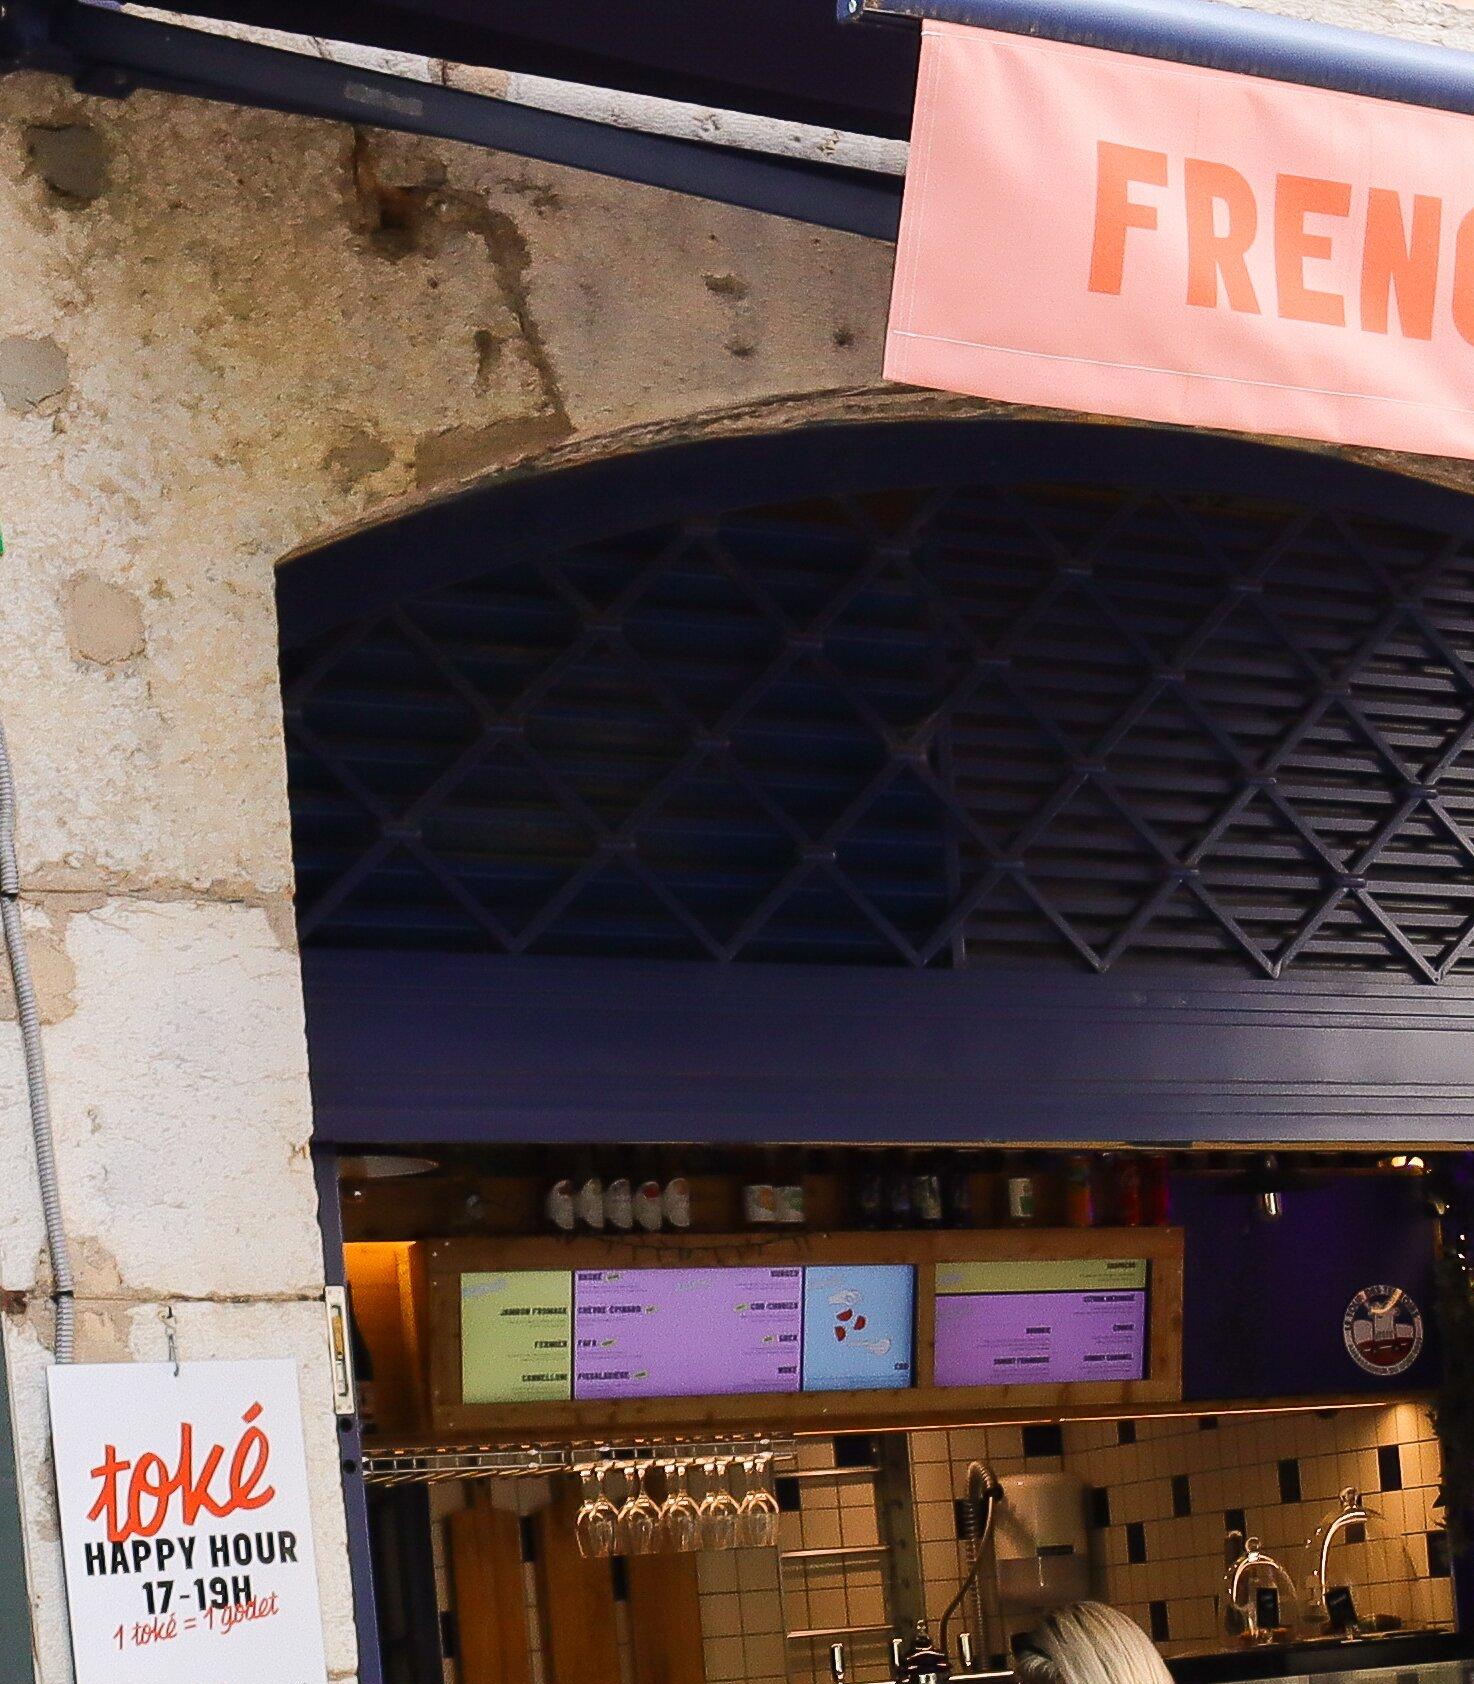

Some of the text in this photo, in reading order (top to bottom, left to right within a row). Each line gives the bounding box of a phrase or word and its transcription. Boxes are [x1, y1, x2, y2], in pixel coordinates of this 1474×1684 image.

[87, 1401, 275, 1542] toké
[84, 1530, 298, 1576] HAPPY HOUR
[113, 1624, 124, 1650] 1
[132, 1611, 178, 1646] toké
[203, 1605, 214, 1630] 1
[221, 1591, 280, 1635] godet
[142, 1575, 252, 1615] 17-19H
